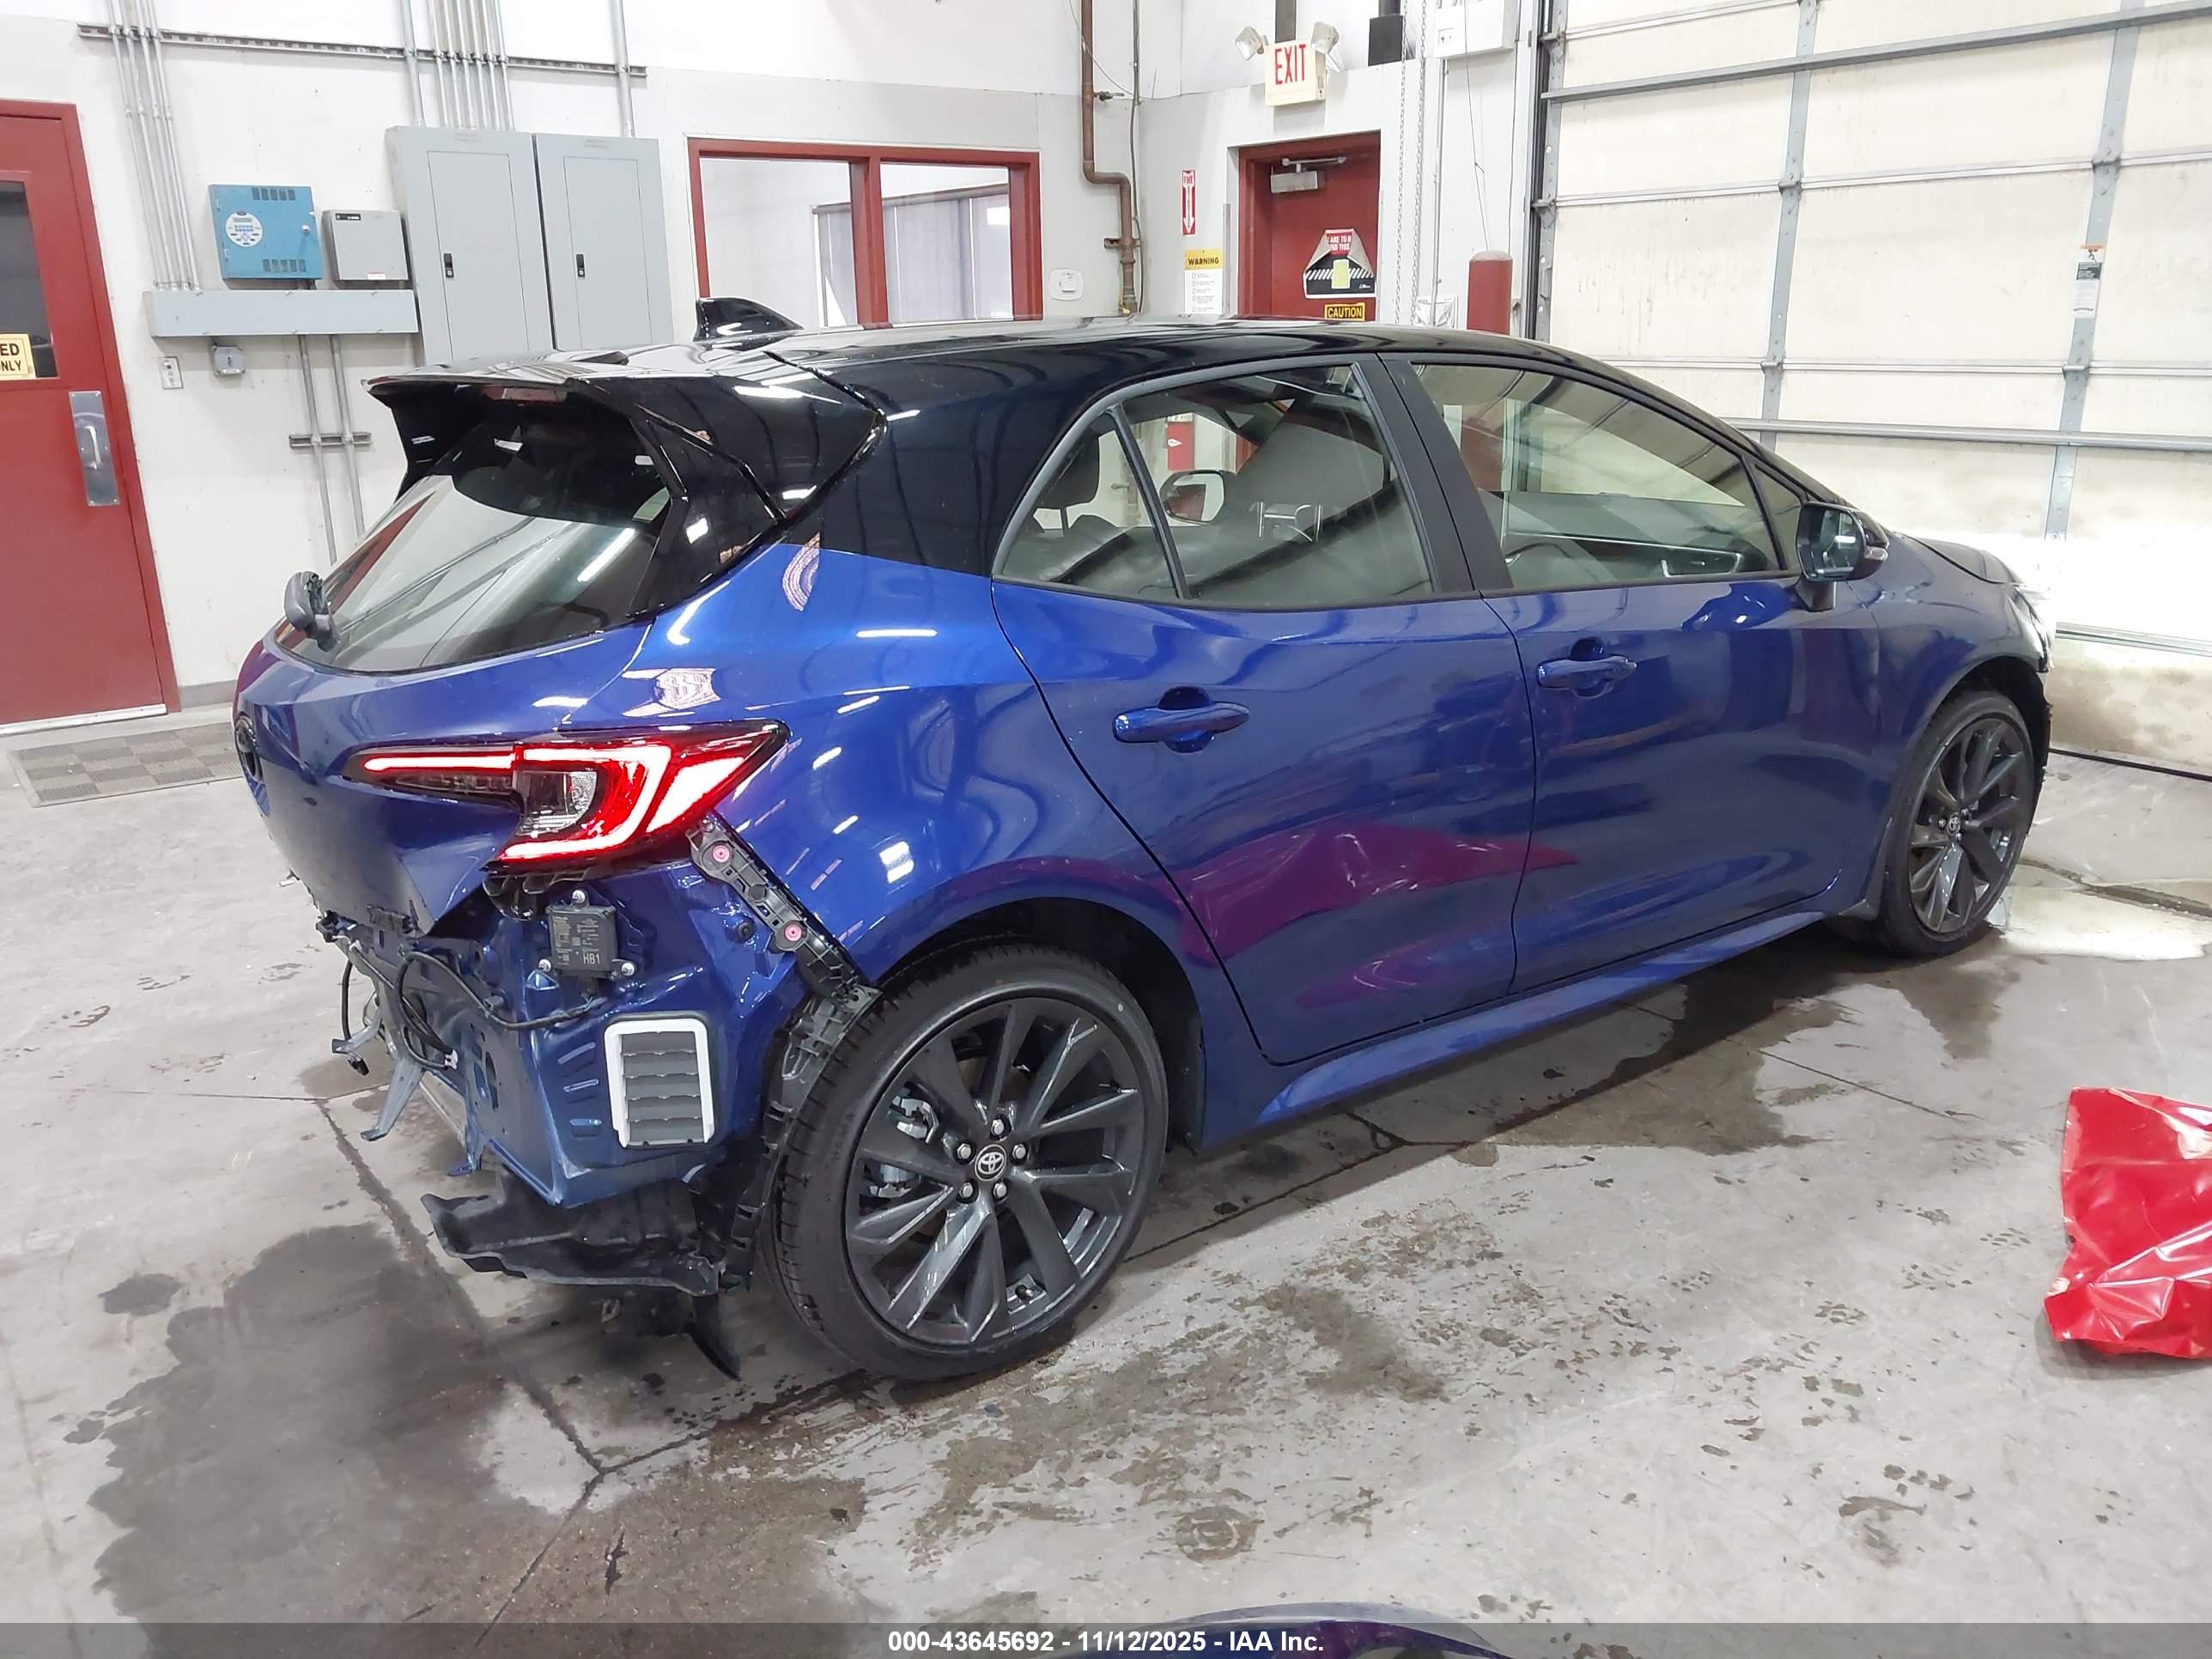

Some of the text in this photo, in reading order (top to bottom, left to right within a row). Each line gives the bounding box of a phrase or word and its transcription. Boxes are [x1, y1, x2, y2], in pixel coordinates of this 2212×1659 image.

[1274, 44, 1306, 85] EXIT
[1188, 257, 1220, 265] WARNING
[1328, 307, 1362, 318] CAUTION
[0, 360, 21, 371] NLY
[582, 952, 600, 964] HB1
